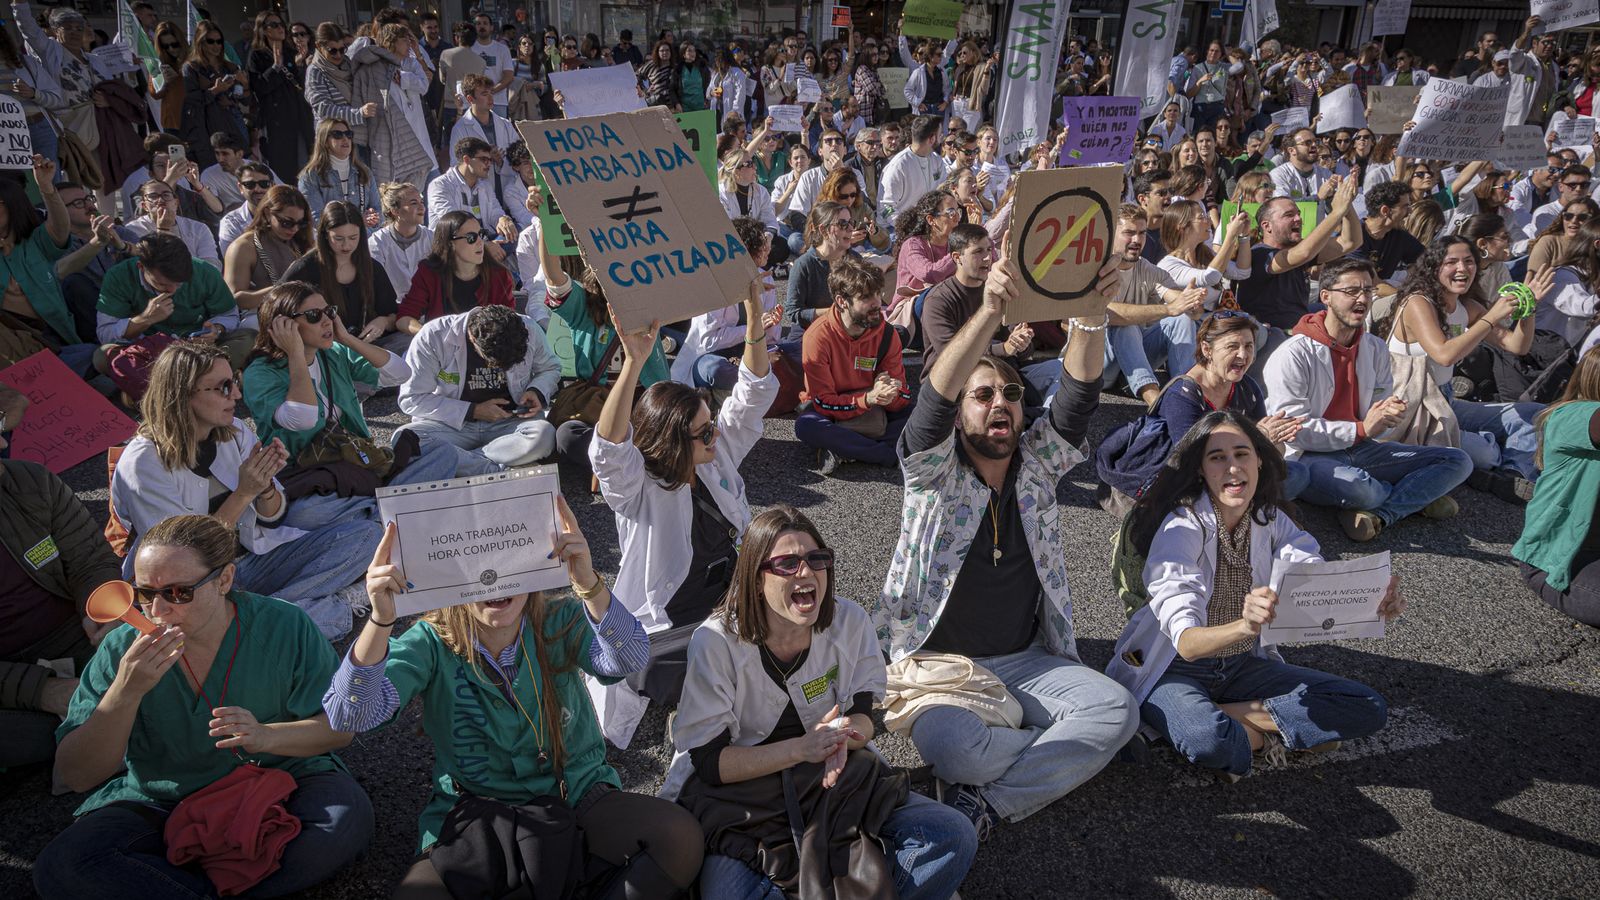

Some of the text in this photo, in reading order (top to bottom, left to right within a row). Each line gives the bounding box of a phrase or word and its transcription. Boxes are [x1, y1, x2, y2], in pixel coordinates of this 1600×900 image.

[1434, 80, 1475, 99] JORNADA
[1420, 106, 1461, 123] GUARDIAS
[9, 133, 30, 149] NO
[544, 122, 624, 152] HORA
[540, 142, 694, 186] TRABAJADA
[589, 219, 670, 252] HORA
[1033, 215, 1103, 265] 24h
[608, 233, 747, 287] COTIZADA
[27, 389, 56, 405] EL
[22, 435, 74, 466] 24H
[431, 522, 528, 545] HORA TRABAJADA
[427, 536, 535, 561] HORA COMPUTADA
[460, 589, 487, 598] Estatuto
[497, 581, 520, 591] Médico
[1290, 590, 1331, 598] DERECHO
[1339, 587, 1381, 596] NEGOCIAR
[1312, 596, 1368, 607] CONDICIONES
[803, 676, 827, 689] HUELGA
